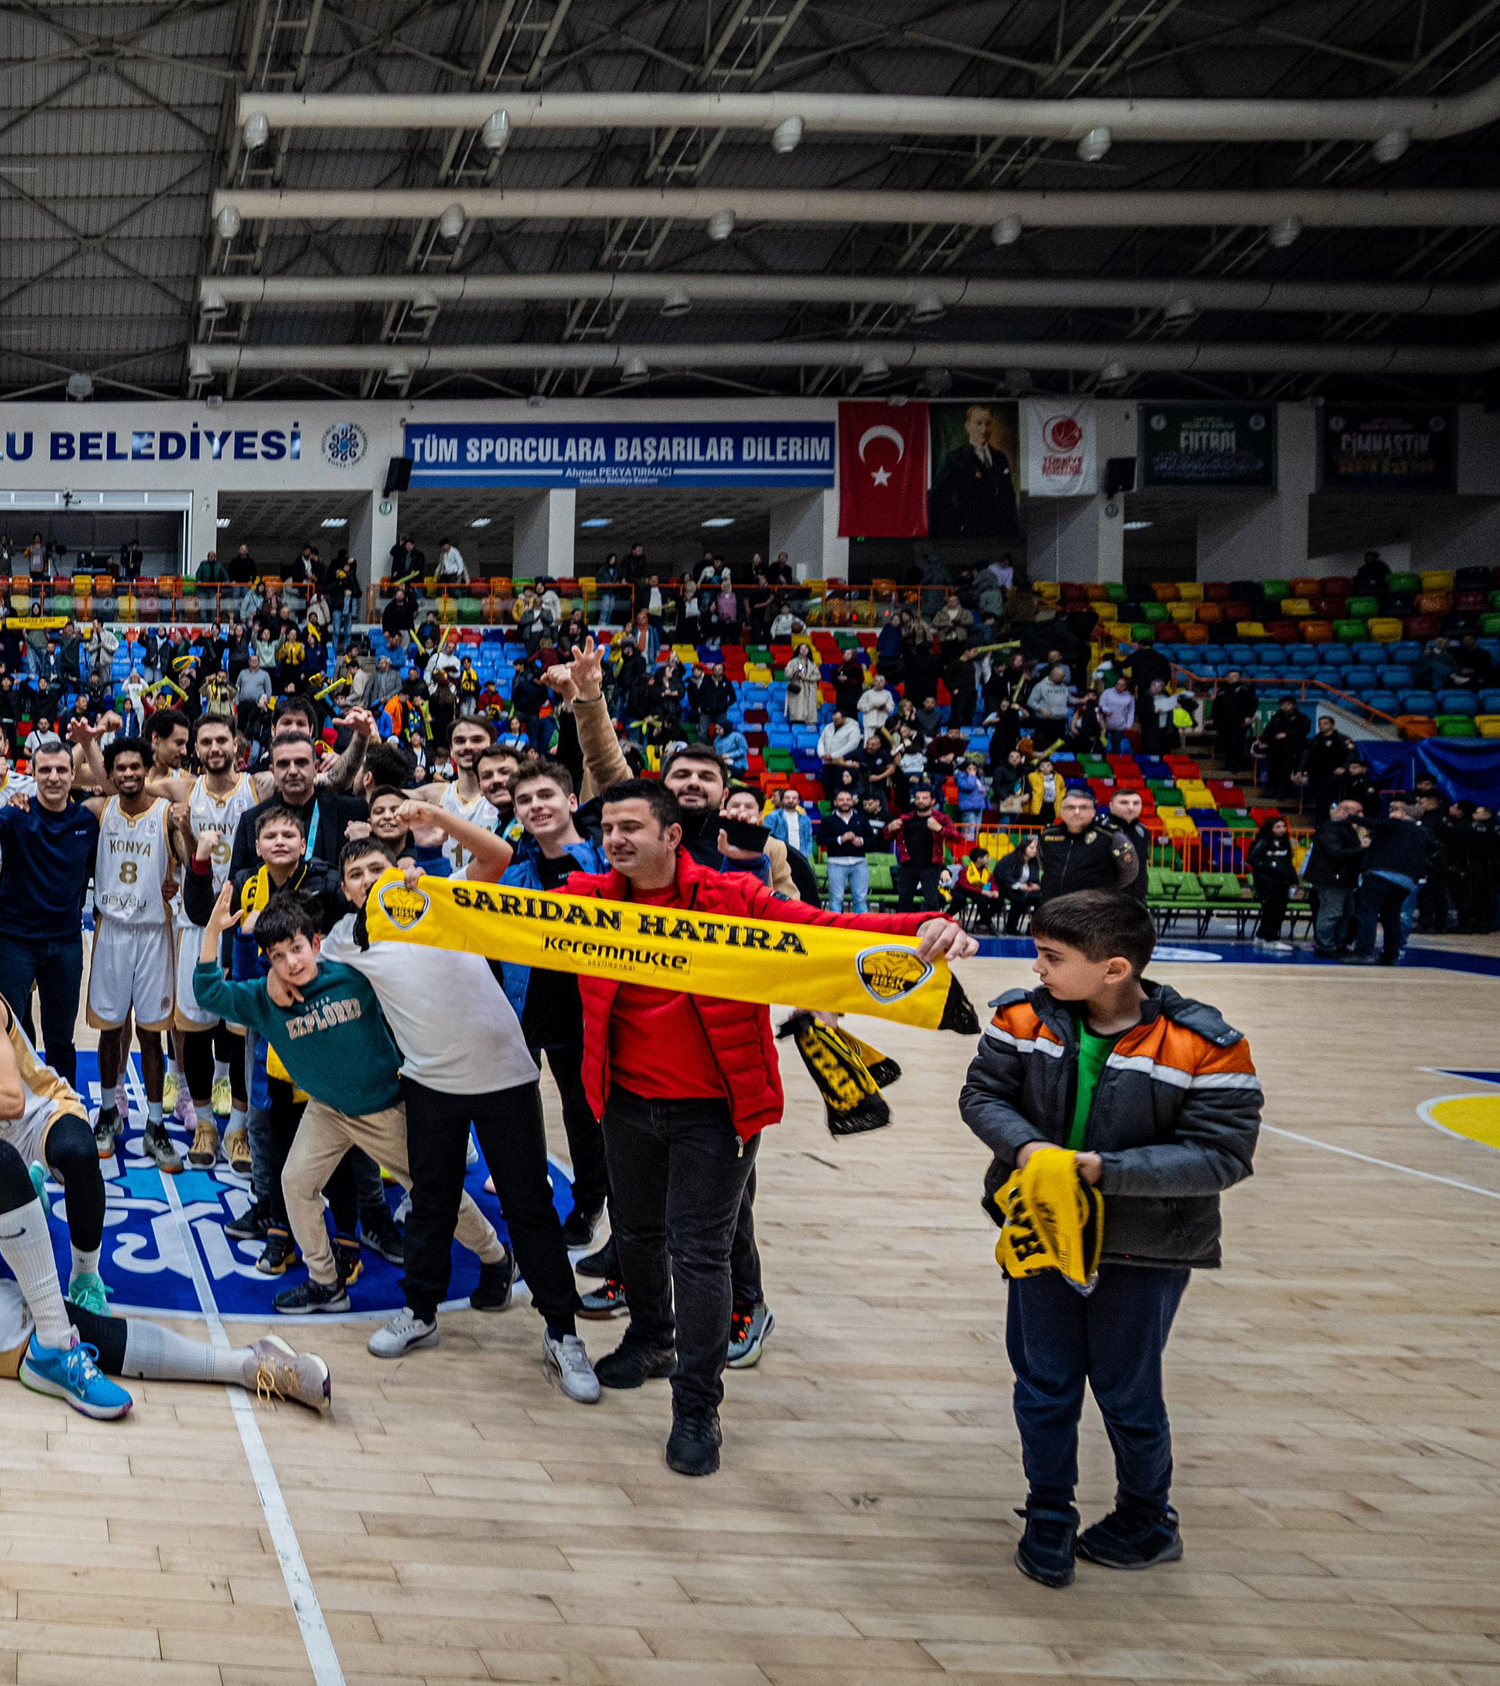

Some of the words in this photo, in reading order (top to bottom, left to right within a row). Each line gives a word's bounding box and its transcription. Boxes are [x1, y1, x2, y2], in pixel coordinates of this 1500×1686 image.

[50, 421, 300, 461] BELEDİYESİ
[412, 434, 457, 463] TÜM
[466, 437, 606, 462] SPORCULARA
[615, 437, 734, 465] BAŞARILAR
[565, 467, 596, 477] Ahmet
[199, 823, 235, 835] KONY
[109, 839, 152, 857] KONYA
[119, 861, 138, 884] 8
[452, 887, 622, 931] SARIDAN
[638, 911, 809, 956] HATIRA
